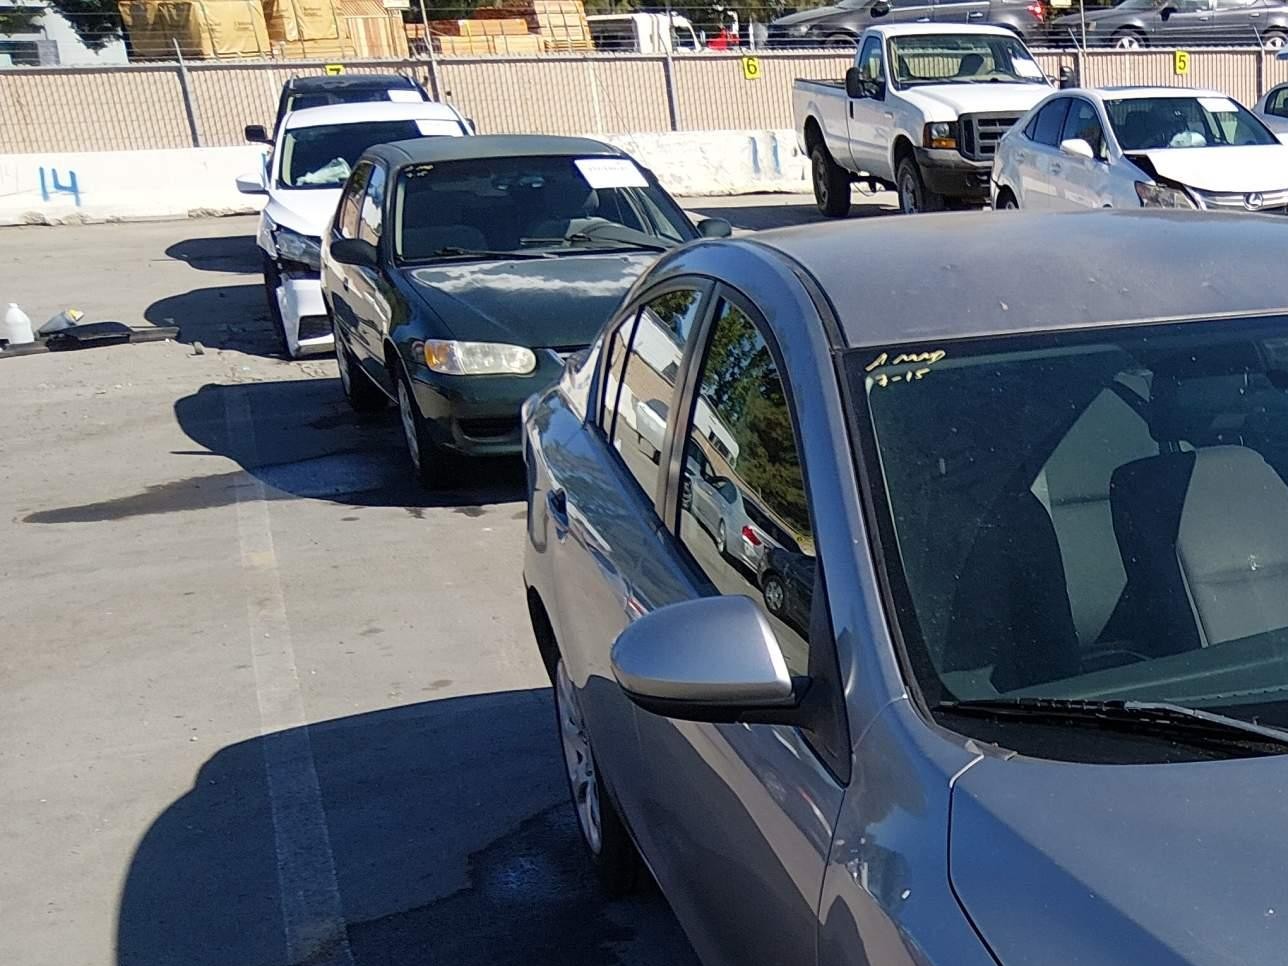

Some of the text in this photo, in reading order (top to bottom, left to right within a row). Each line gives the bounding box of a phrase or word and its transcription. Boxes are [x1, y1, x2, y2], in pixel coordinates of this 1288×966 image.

[746, 57, 757, 75] 6
[1178, 54, 1186, 70] 5
[38, 166, 80, 207] 14
